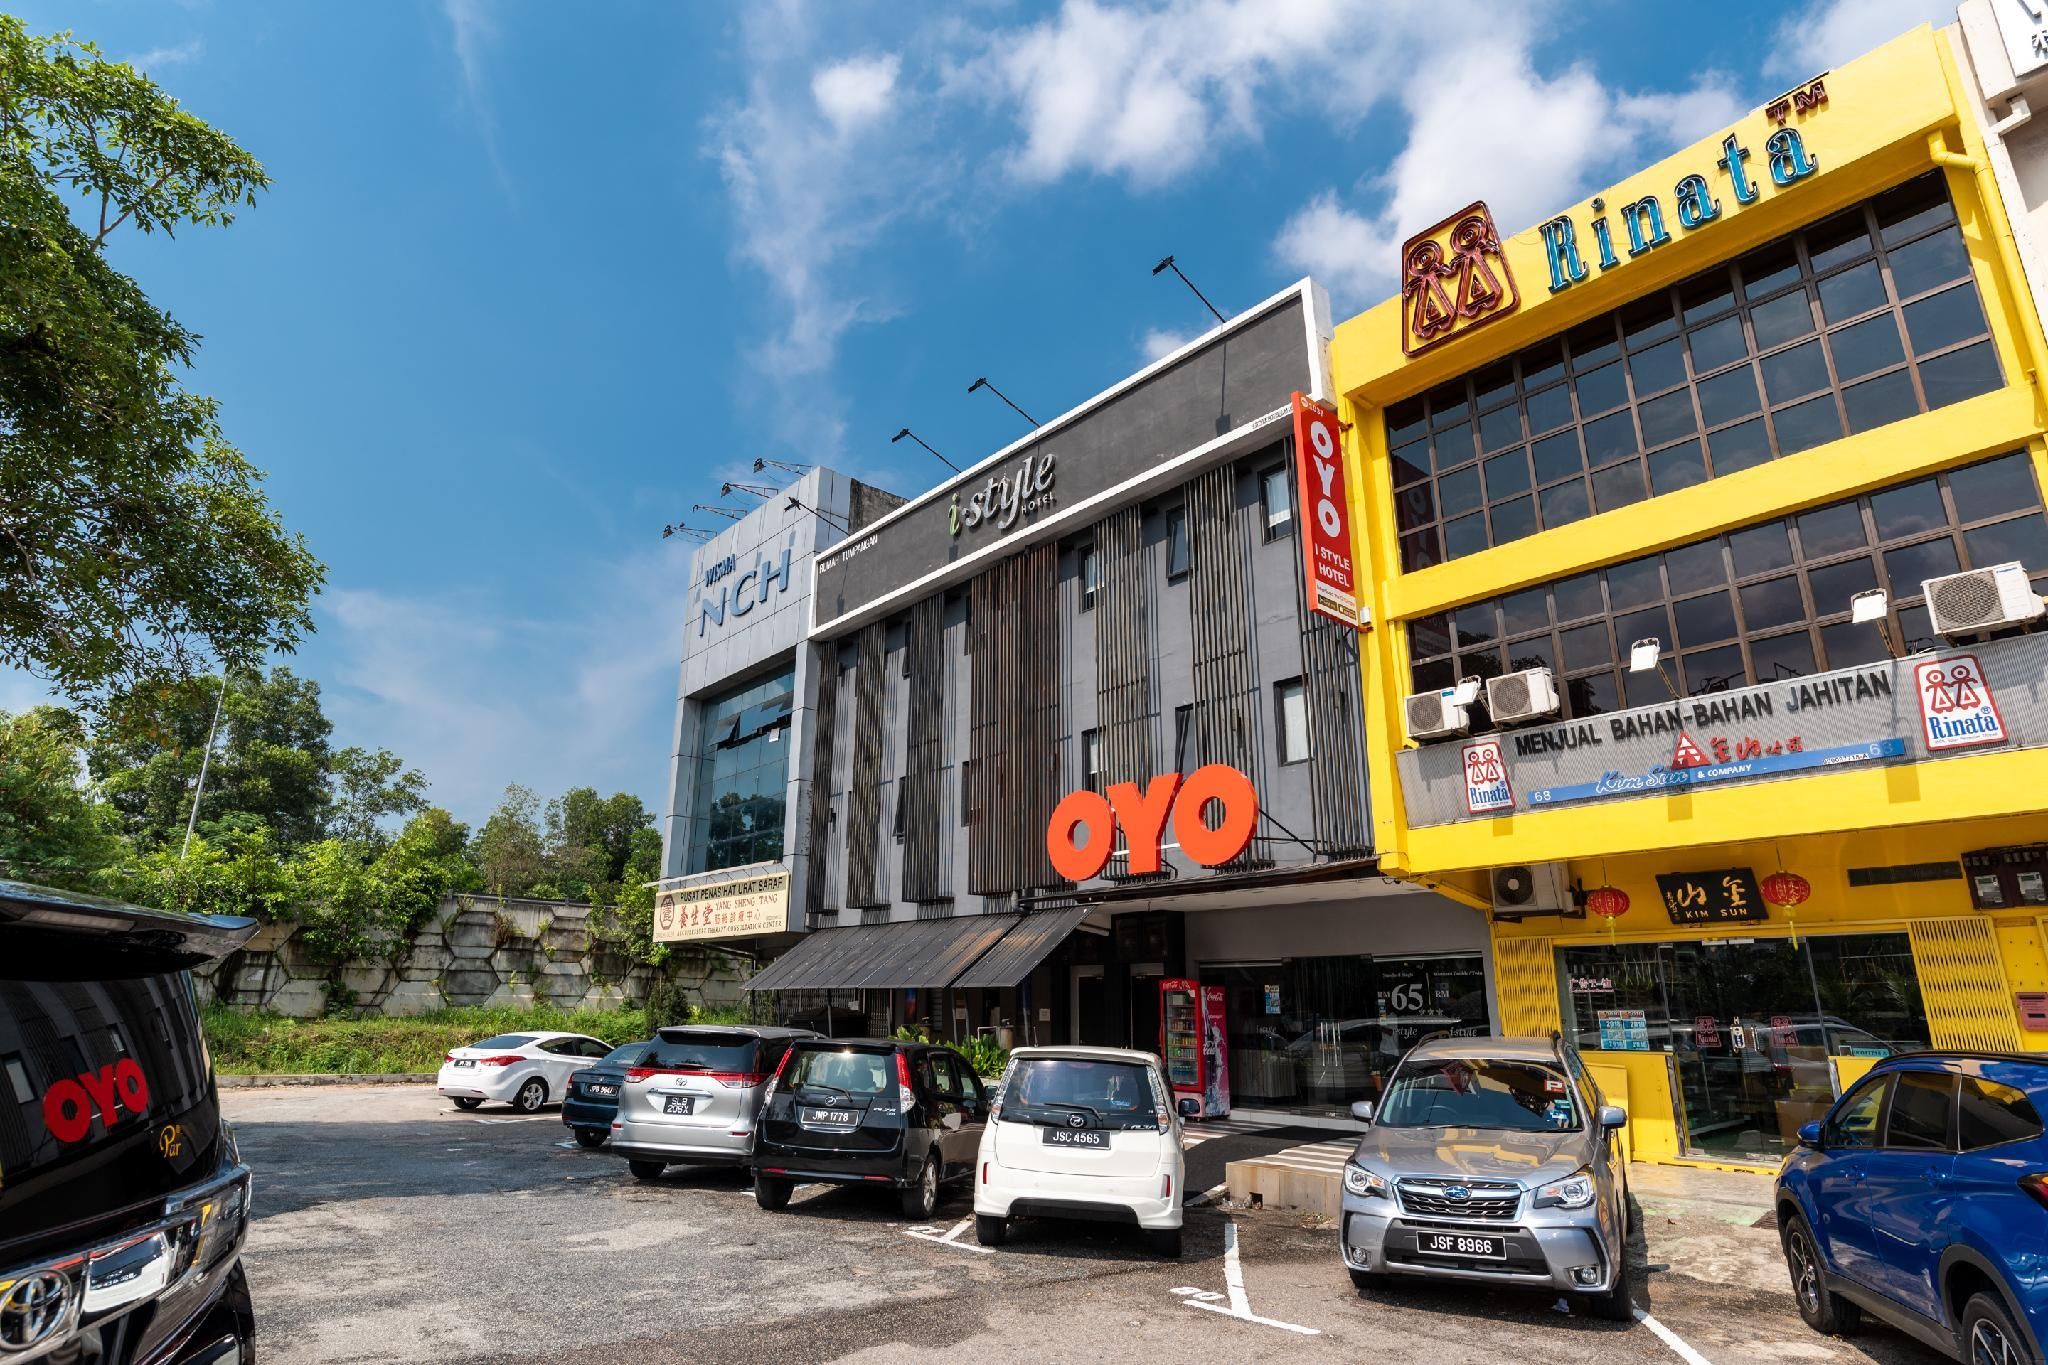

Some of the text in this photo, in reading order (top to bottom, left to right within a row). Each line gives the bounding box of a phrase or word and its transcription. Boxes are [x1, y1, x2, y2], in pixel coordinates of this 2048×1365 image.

[1765, 81, 1829, 124] TM
[1539, 127, 1820, 294] Rinata
[1310, 421, 1341, 538] OYO
[1021, 491, 1057, 515] HOTEL
[1315, 543, 1351, 571] I STYLE
[705, 553, 736, 588] WISMA
[1318, 562, 1351, 588] HOTEL
[698, 548, 792, 637] NCH
[1515, 669, 1893, 757] MENJUAL BAHAN-BAHAN JAHITAN
[1928, 711, 1999, 740] Rinata
[1697, 770, 1706, 779] &
[1707, 763, 1752, 777] COMPANY
[1469, 785, 1510, 805] Rinata
[1534, 790, 1552, 802] 68
[1047, 763, 1260, 882] OYO
[680, 890, 699, 902] PUSAT
[738, 881, 757, 895] URAT
[758, 876, 783, 892] SARAF
[715, 893, 778, 911] YANG SHENG TANG
[1685, 908, 1747, 919] KIM SUN
[1391, 983, 1424, 1011] 65
[1435, 990, 1450, 999] RM
[1546, 1080, 1563, 1091] P
[830, 1111, 849, 1122] 1778
[1052, 1131, 1100, 1144] JSC 4565
[1429, 1235, 1493, 1253] JSF 8966
